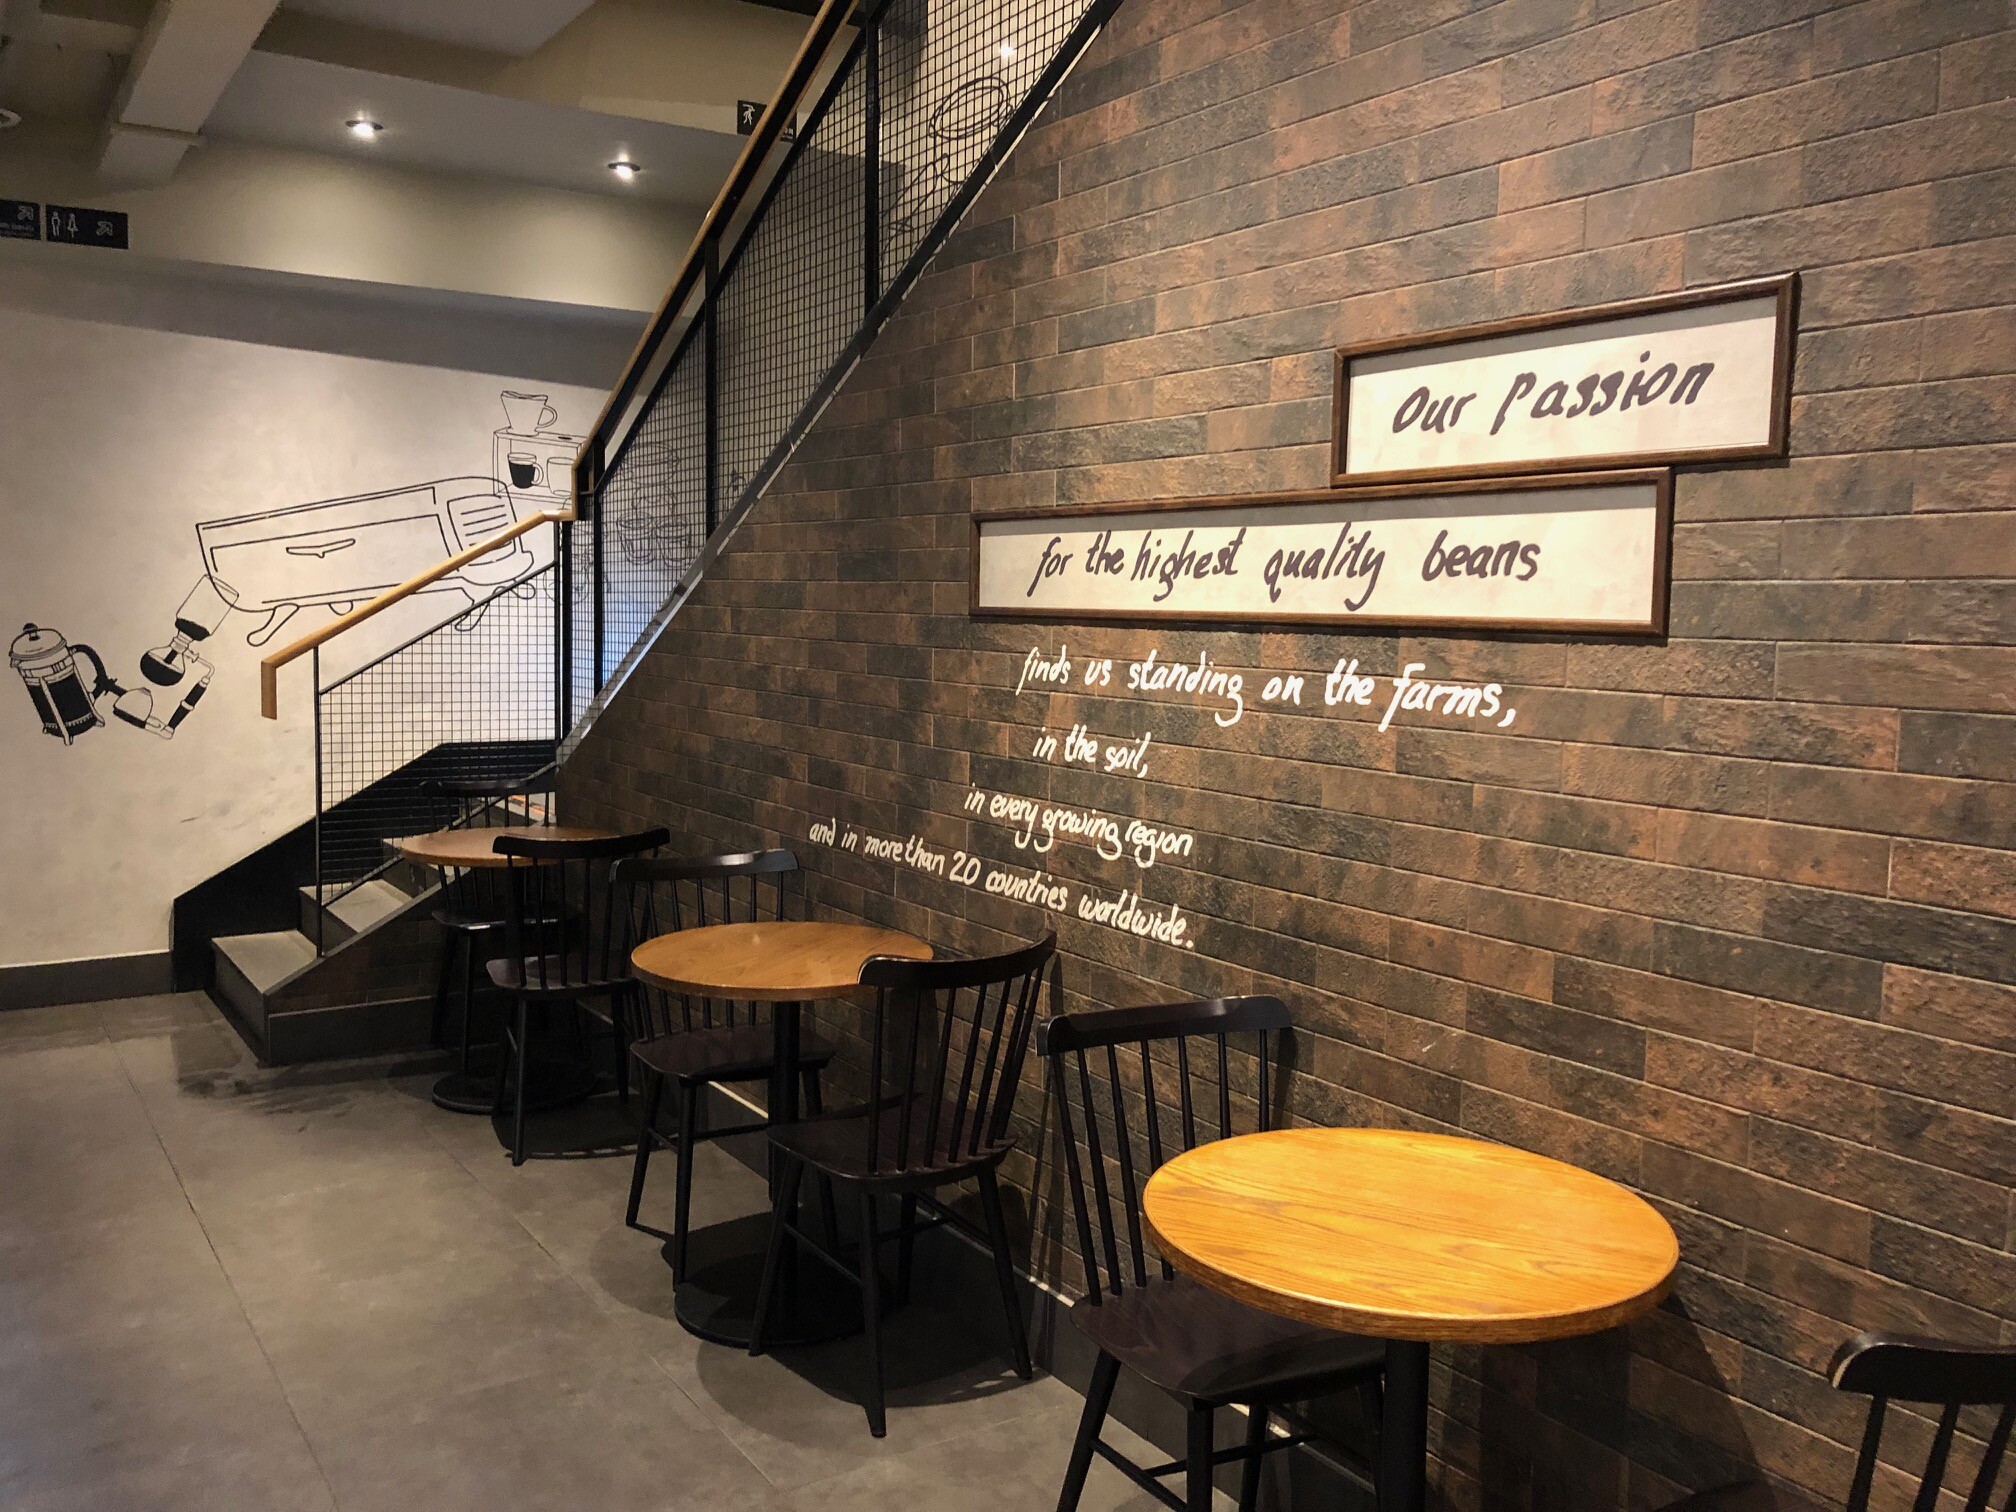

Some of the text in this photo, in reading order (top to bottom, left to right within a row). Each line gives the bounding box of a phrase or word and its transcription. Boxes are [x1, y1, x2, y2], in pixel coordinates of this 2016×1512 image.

[1392, 350, 1715, 436] Our Passion
[1027, 521, 1540, 611] for the highest quality beans
[1015, 645, 1516, 733] finds us standing on the farms,
[1032, 724, 1151, 778] in the soil,
[964, 783, 1193, 868] in every growing region
[809, 817, 1194, 949] and in more than 20 countries worldwide.
